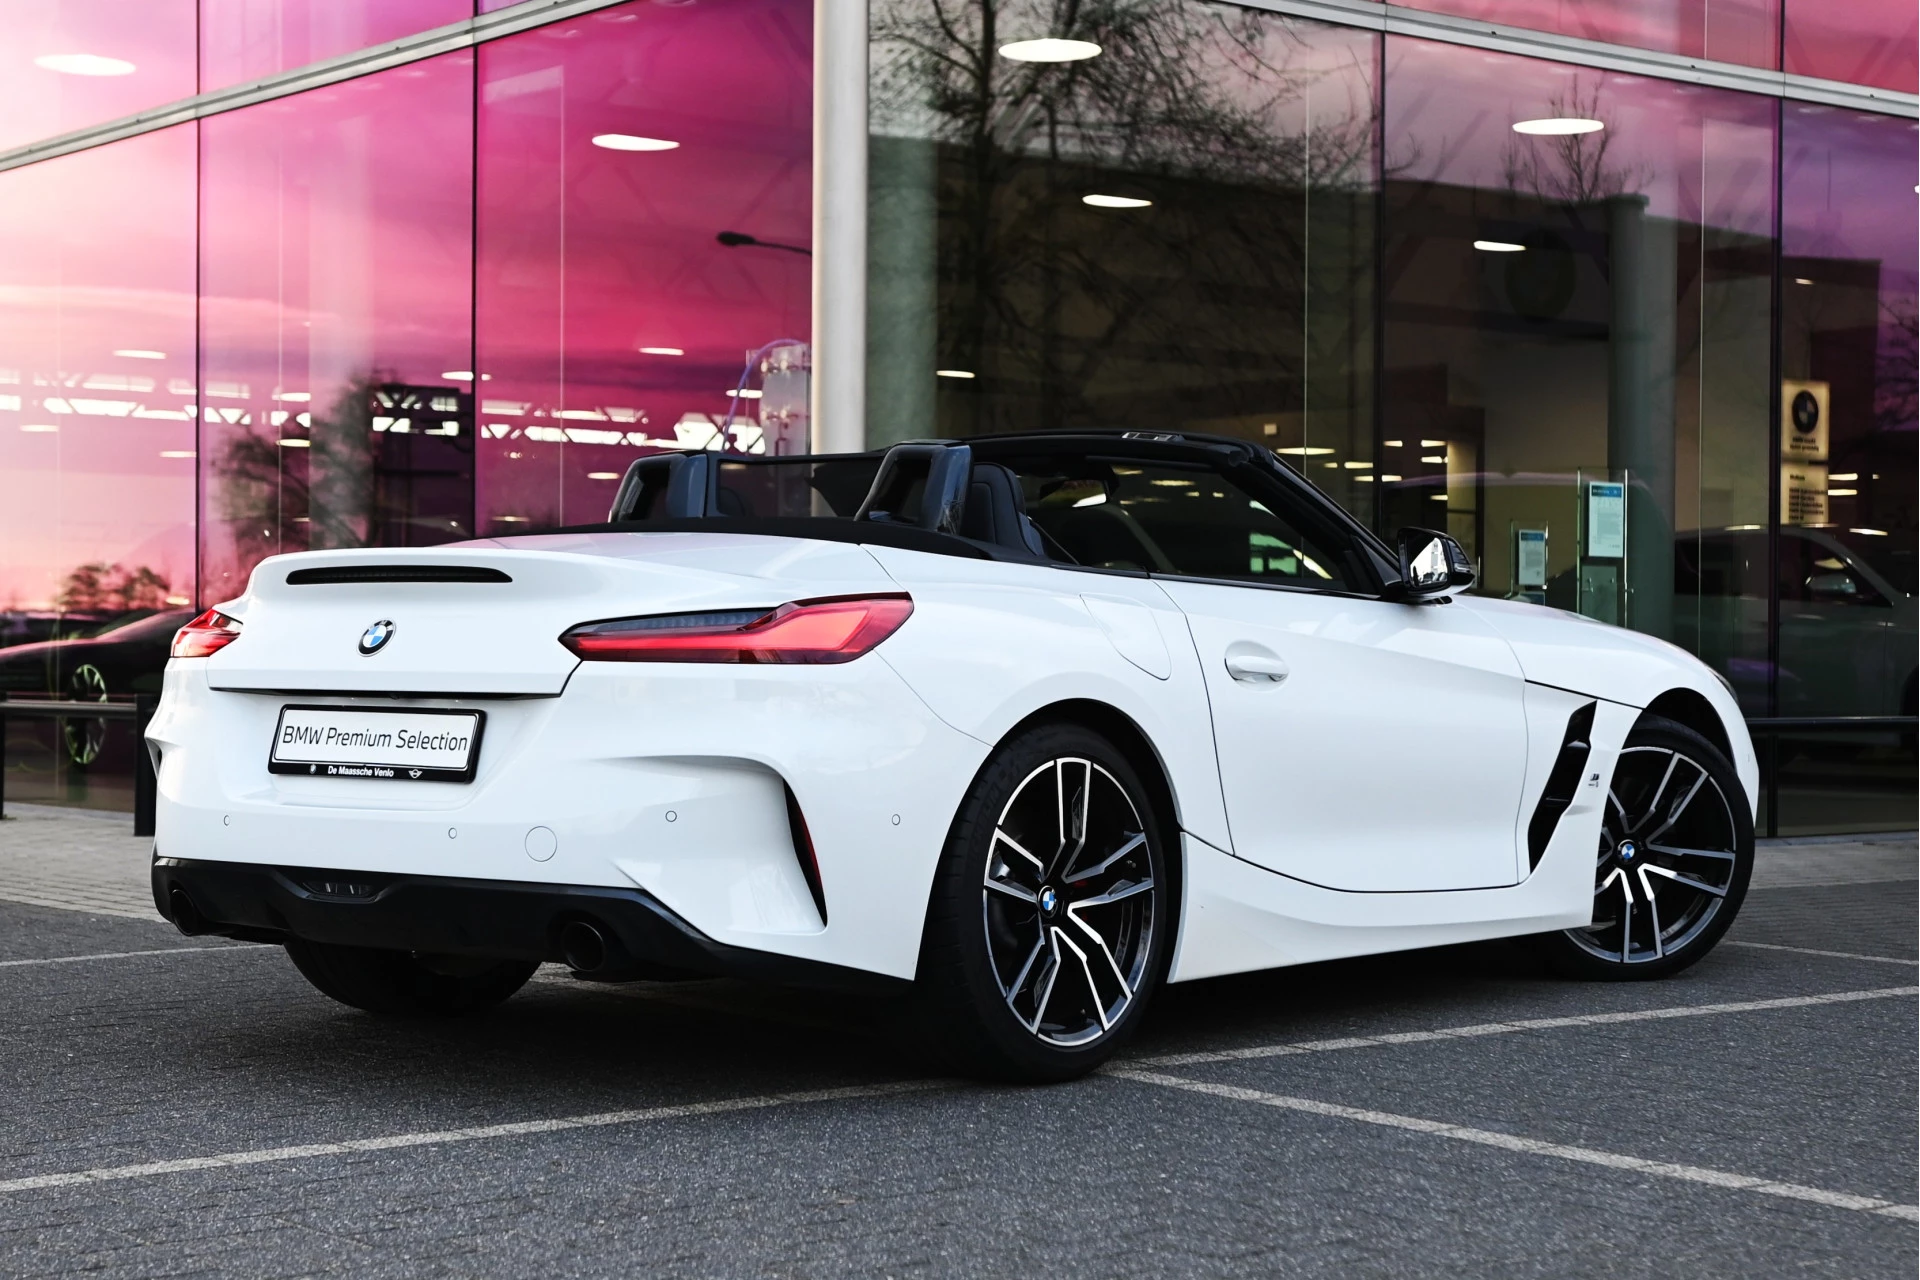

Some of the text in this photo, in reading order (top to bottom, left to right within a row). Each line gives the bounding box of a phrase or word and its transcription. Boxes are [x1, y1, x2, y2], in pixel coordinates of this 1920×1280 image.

[282, 725, 468, 751] BMW Premium Selection
[327, 765, 394, 778] De Maassche Venlo
